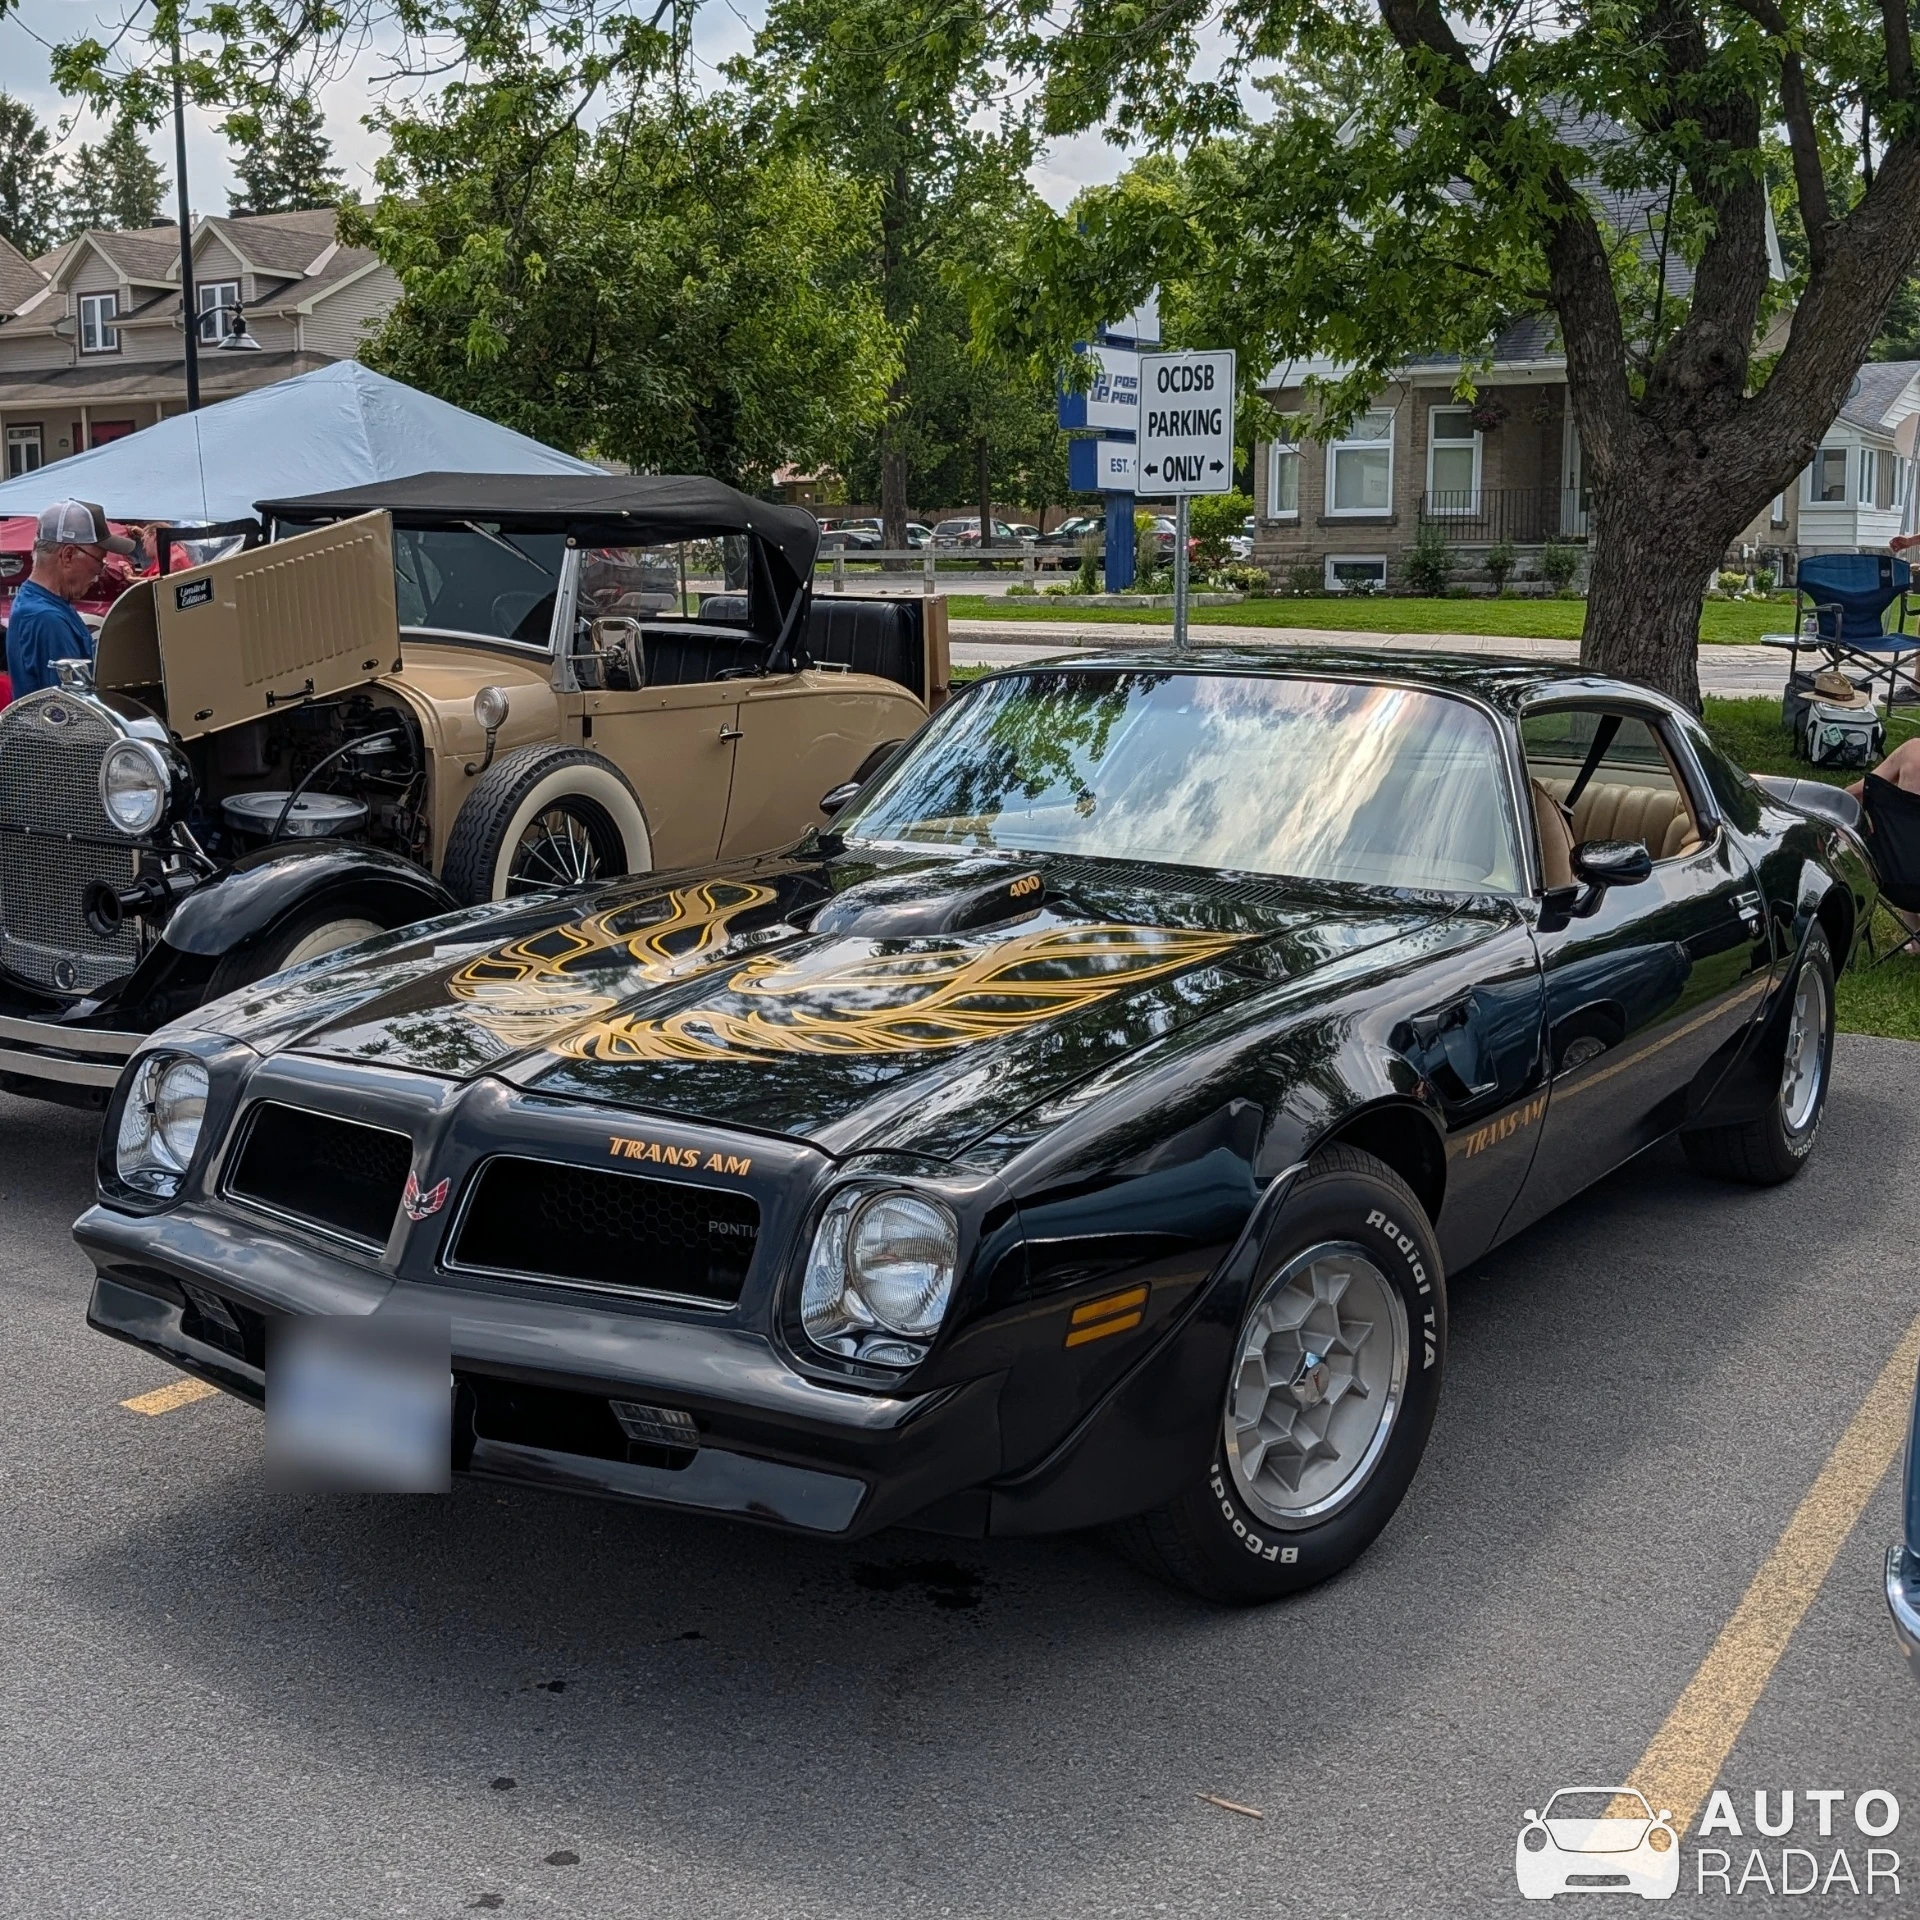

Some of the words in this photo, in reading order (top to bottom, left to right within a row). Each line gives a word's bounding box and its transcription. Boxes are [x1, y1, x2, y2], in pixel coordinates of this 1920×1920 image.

[1157, 364, 1214, 393] OCDSB
[1148, 408, 1222, 437] PARKING
[1110, 458, 1130, 473] EST.
[1163, 455, 1205, 482] ONLY
[1010, 875, 1040, 897] 400
[1465, 1110, 1519, 1159] TRANS
[1520, 1095, 1547, 1127] AM
[609, 1136, 701, 1168] TRANS
[703, 1153, 751, 1176] AM
[1365, 1208, 1431, 1295] Radial
[1423, 1305, 1436, 1370] T/A
